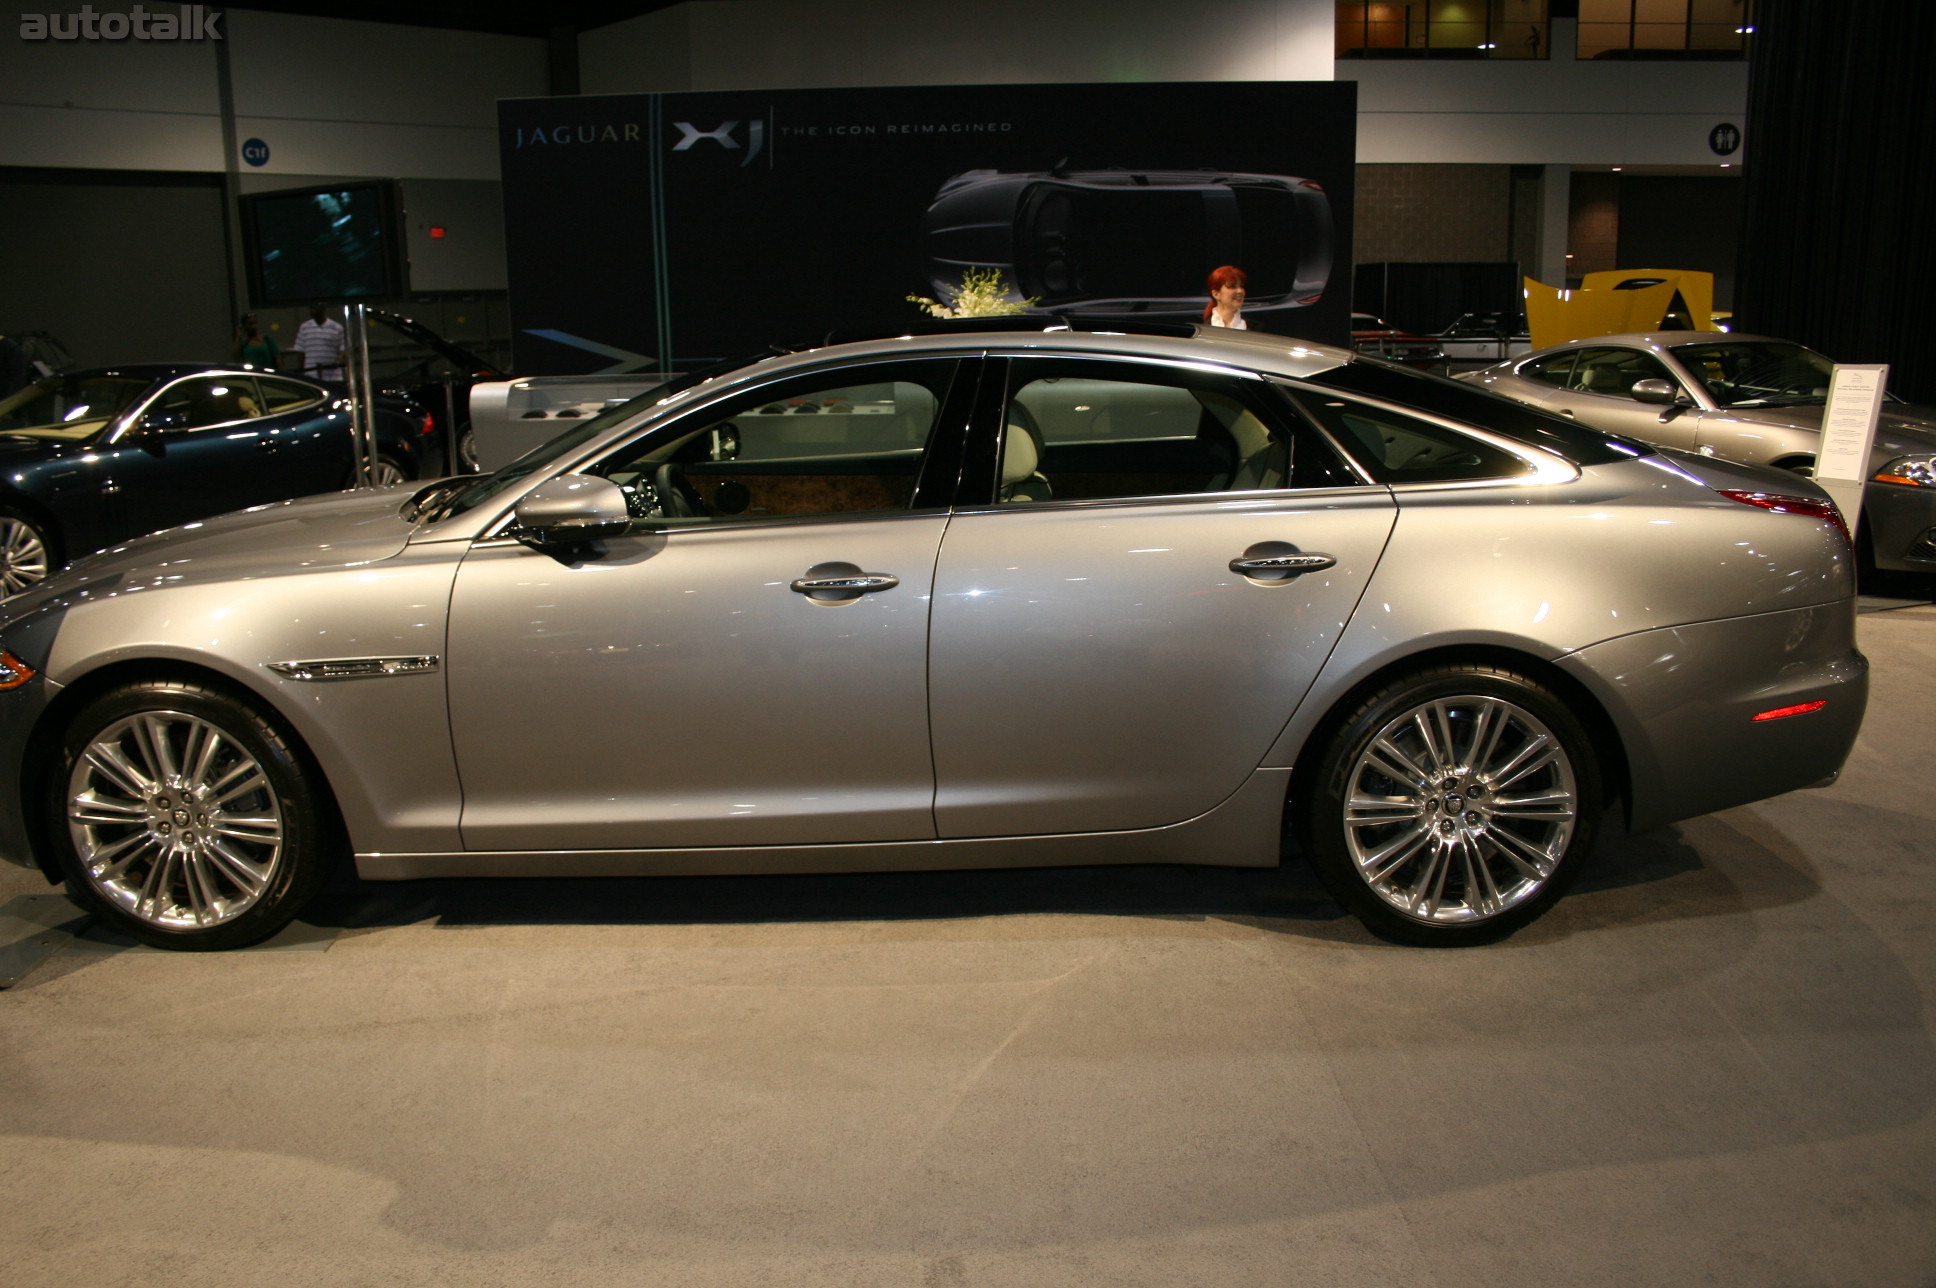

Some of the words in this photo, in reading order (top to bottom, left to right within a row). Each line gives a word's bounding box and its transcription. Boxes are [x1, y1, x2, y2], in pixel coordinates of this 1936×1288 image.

[516, 124, 640, 149] JAGUAR
[781, 127, 817, 136] THE
[829, 126, 876, 135] ICON
[888, 123, 1012, 134] REIMAGINED
[672, 120, 763, 167] XJ
